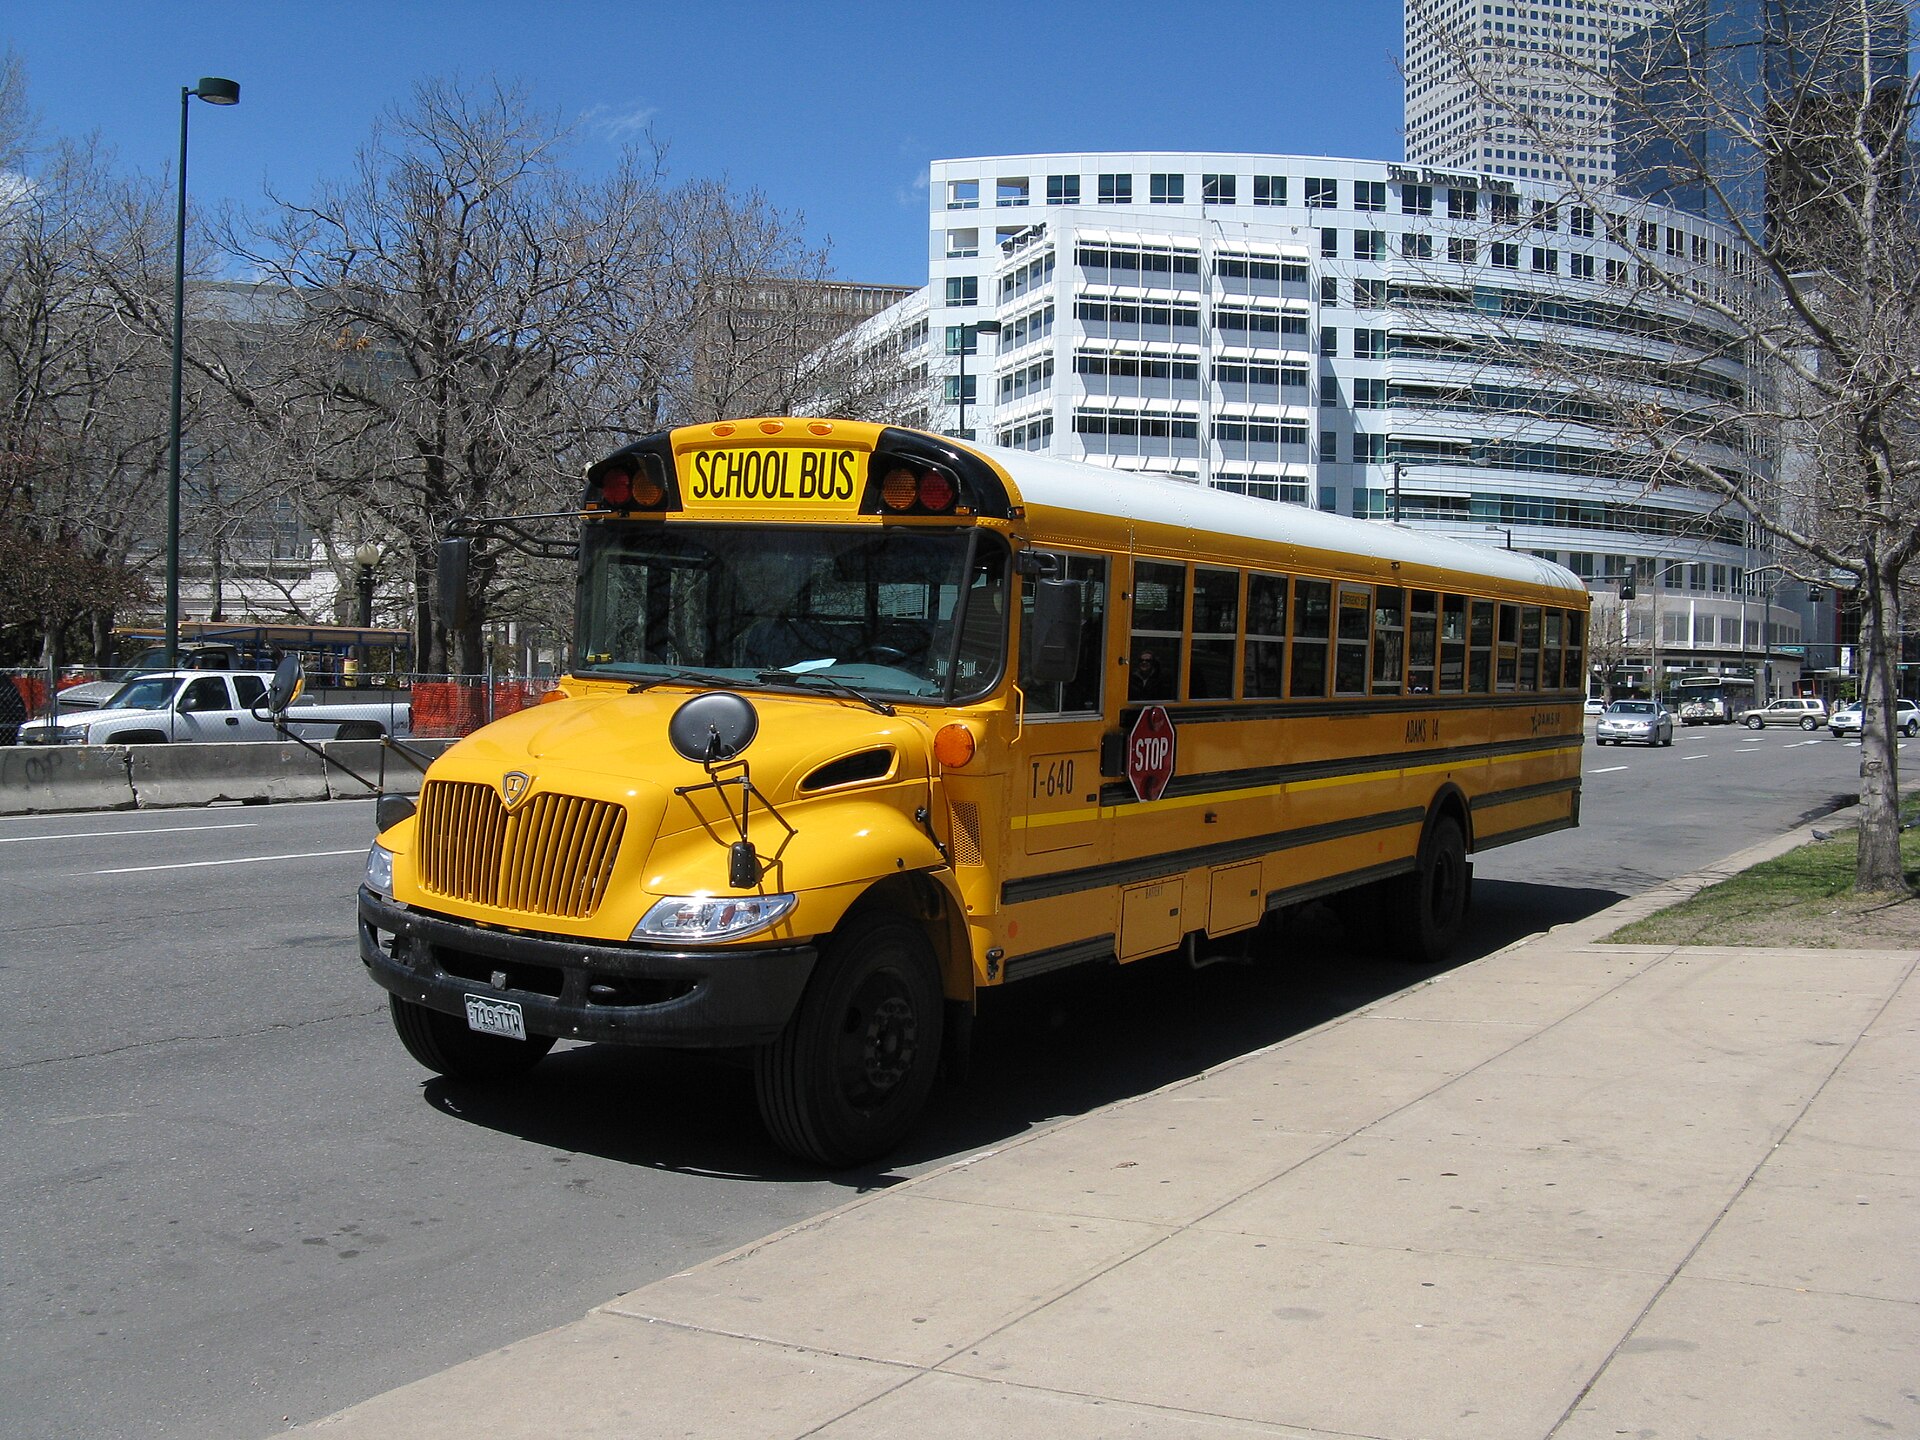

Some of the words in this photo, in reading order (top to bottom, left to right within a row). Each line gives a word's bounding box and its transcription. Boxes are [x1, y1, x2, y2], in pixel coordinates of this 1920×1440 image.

[1420, 167, 1479, 190] DENVER
[1480, 173, 1516, 194] POST
[693, 450, 794, 499] SCHOOL
[799, 450, 855, 500] BUS
[1405, 719, 1426, 744] ADAMS
[1432, 718, 1439, 742] 14
[1135, 736, 1169, 772] STOP
[1032, 759, 1074, 798] T-640
